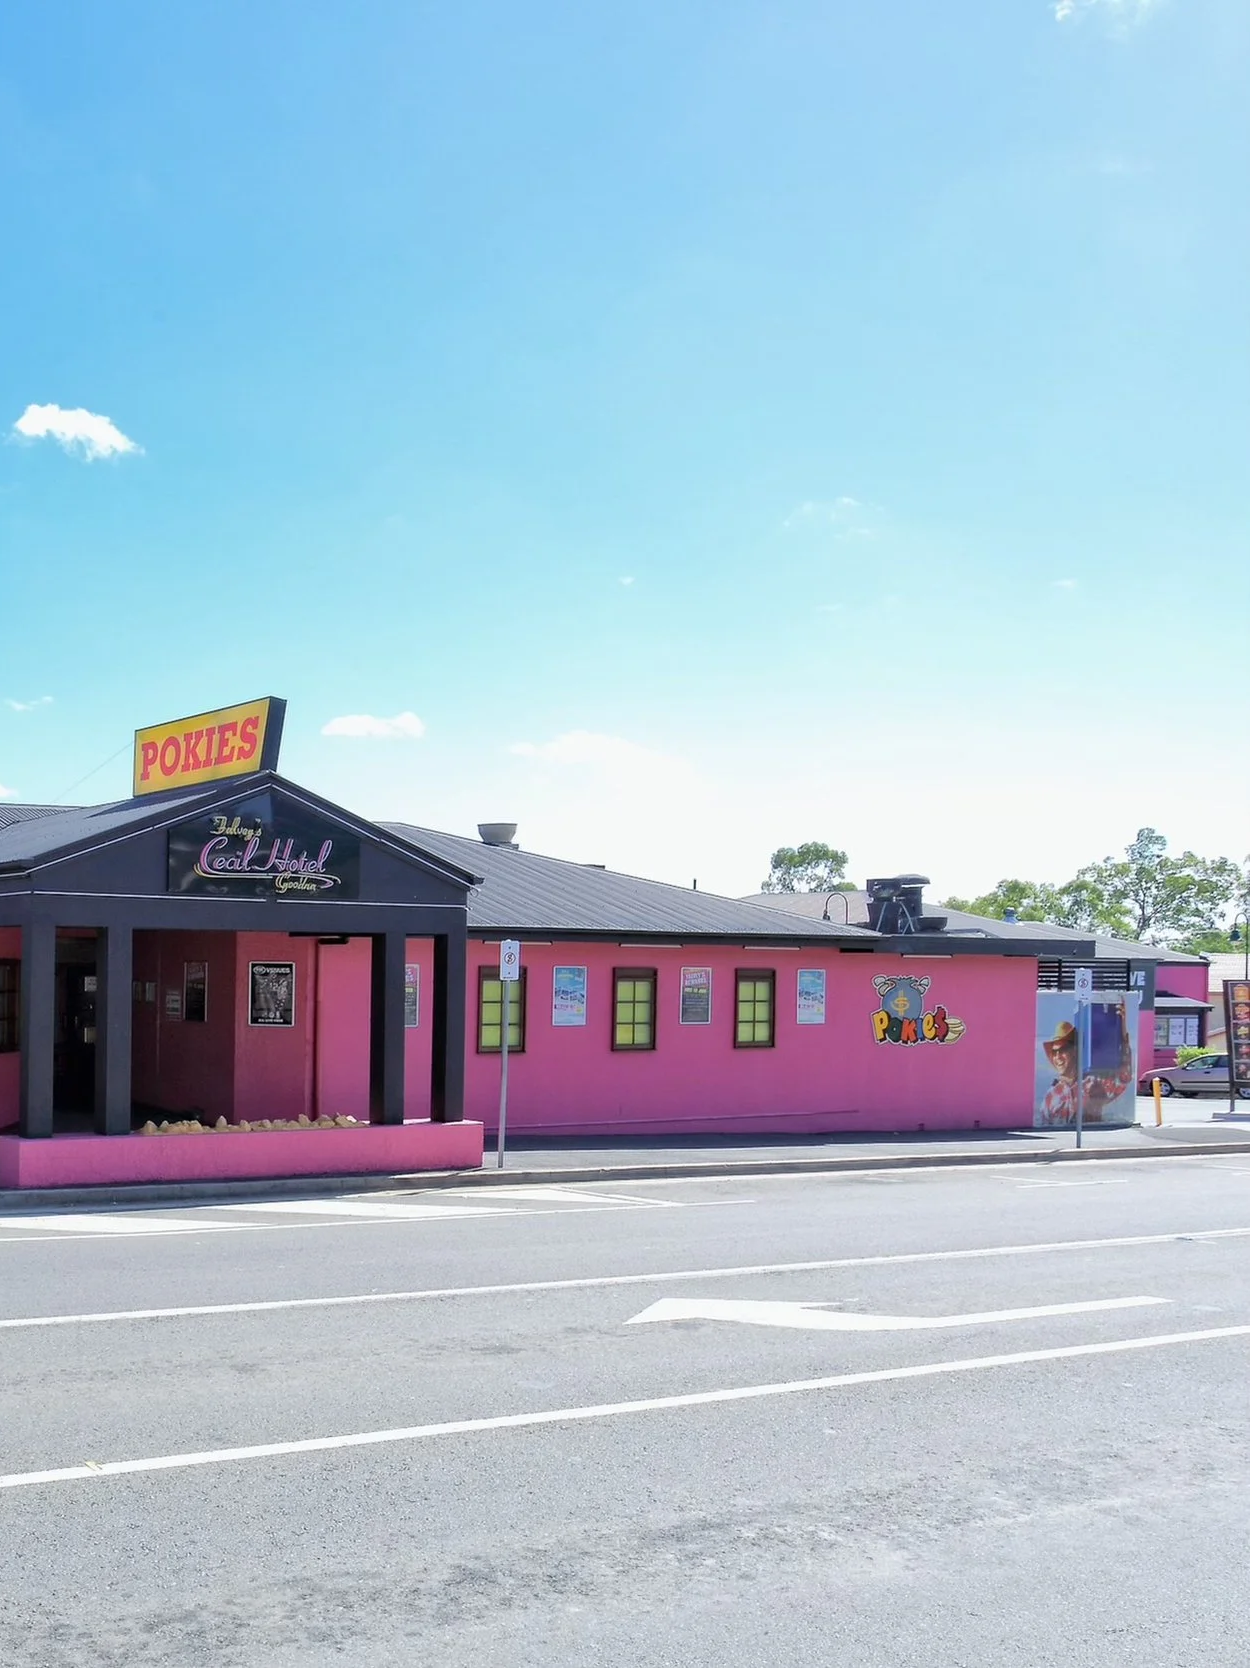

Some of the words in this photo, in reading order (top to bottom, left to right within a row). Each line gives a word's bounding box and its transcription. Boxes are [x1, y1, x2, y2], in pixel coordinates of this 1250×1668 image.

[140, 715, 260, 781] POKIES
[200, 836, 260, 874] Cecil
[258, 838, 333, 873] Hotel
